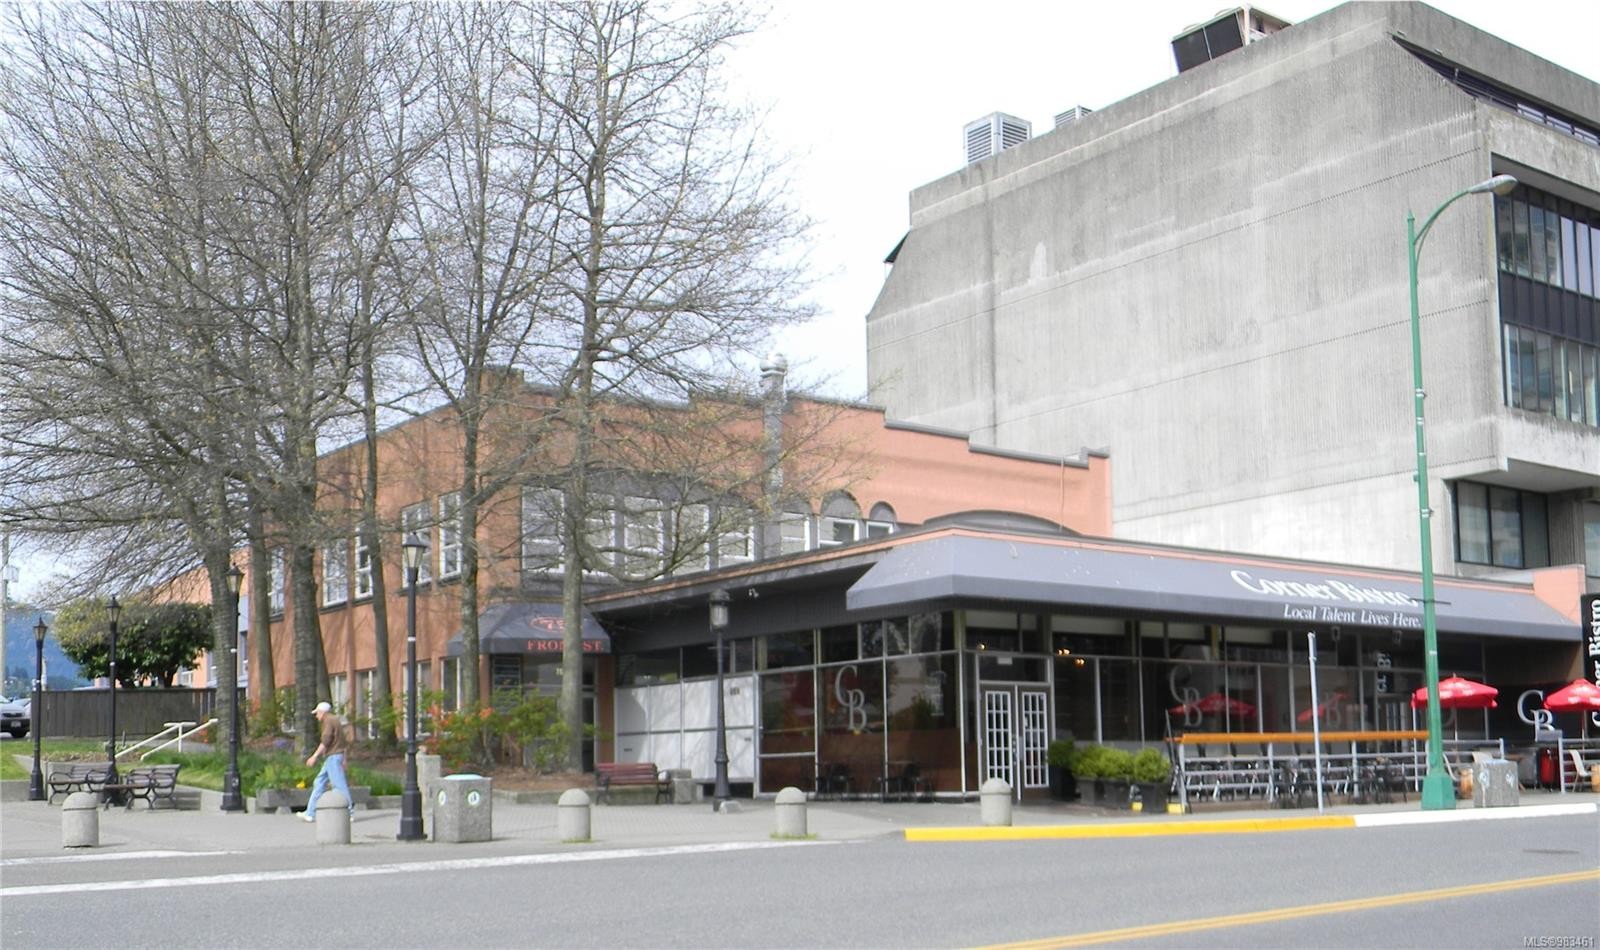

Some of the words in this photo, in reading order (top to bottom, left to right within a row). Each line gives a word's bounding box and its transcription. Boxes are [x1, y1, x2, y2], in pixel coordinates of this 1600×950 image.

[1230, 570, 1338, 600] Corner
[1283, 603, 1316, 619] Local
[1319, 607, 1356, 623] Talent
[1360, 610, 1389, 624] Lives
[1392, 612, 1421, 628] Here.
[583, 640, 604, 652] ST.
